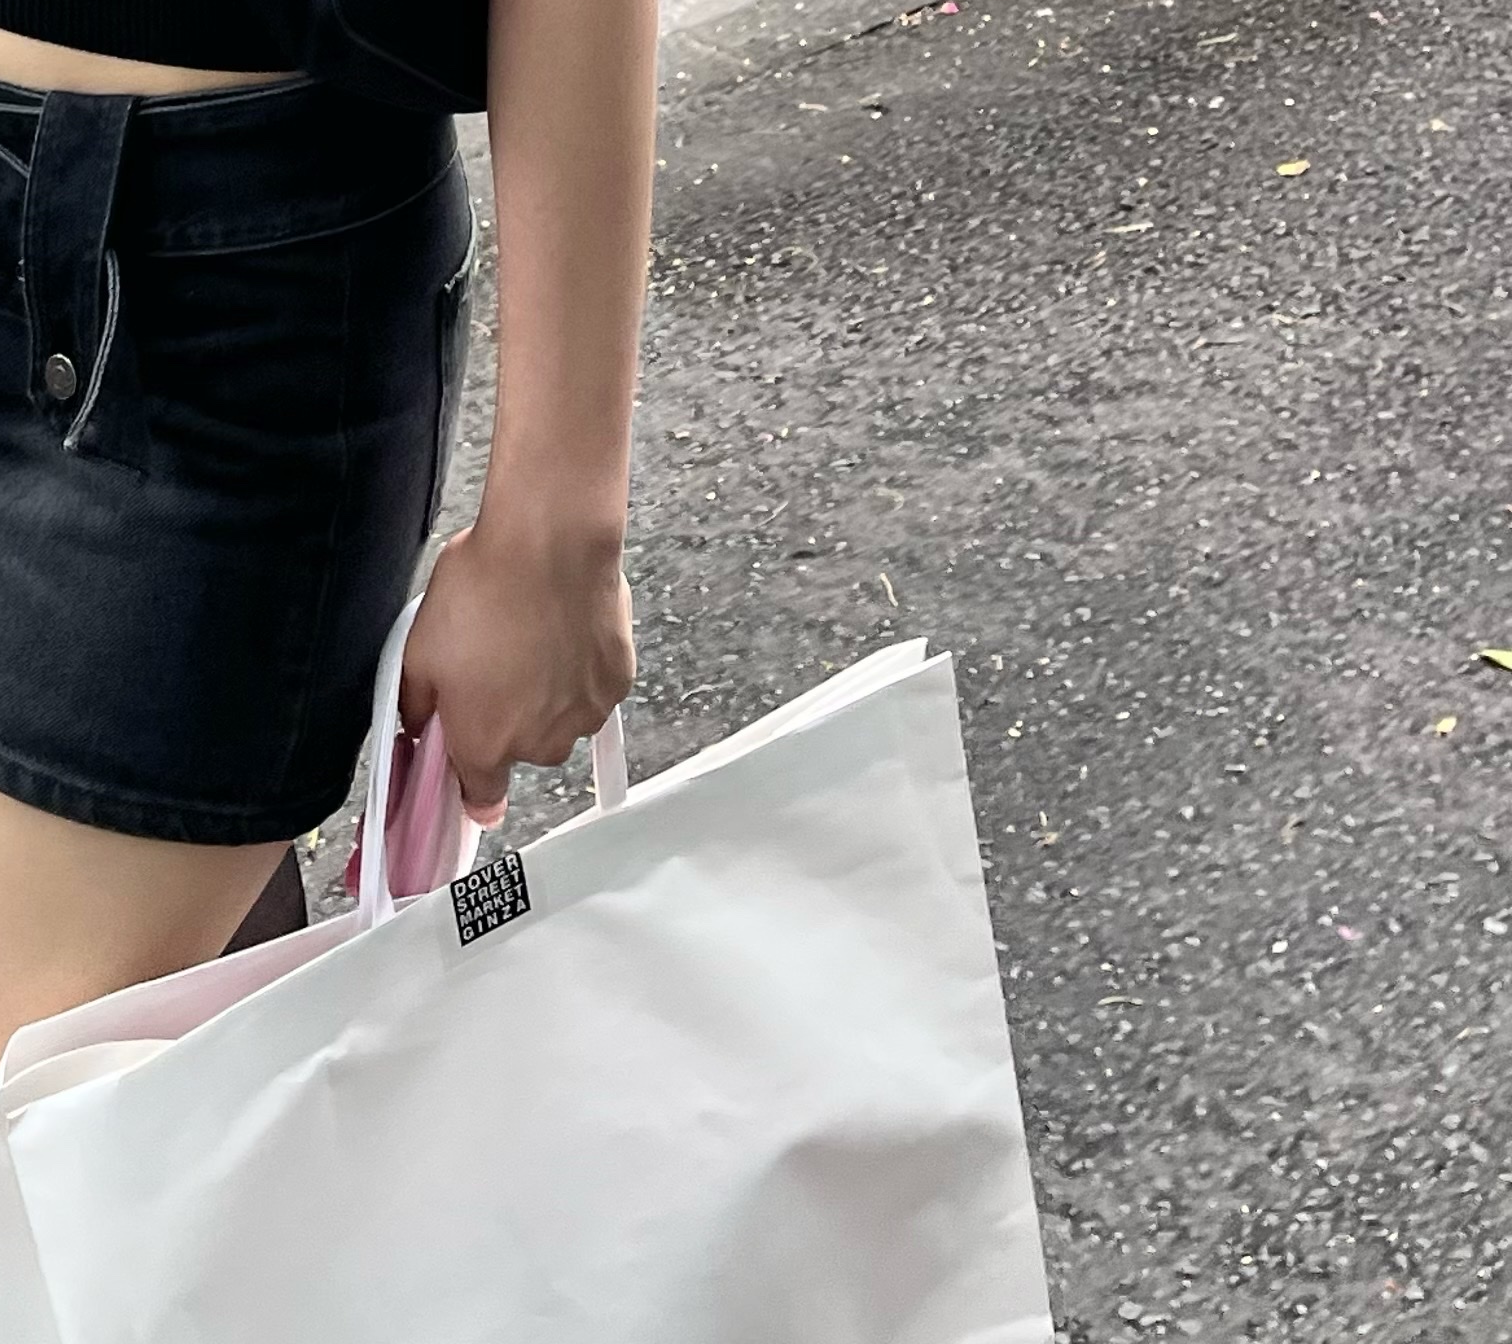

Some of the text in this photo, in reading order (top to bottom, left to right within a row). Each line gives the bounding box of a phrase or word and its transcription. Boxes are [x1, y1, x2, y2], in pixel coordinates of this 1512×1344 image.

[454, 853, 519, 898] DOVER
[456, 868, 520, 912] STREET
[459, 883, 523, 927] MARKET
[463, 899, 526, 940] GINZA
